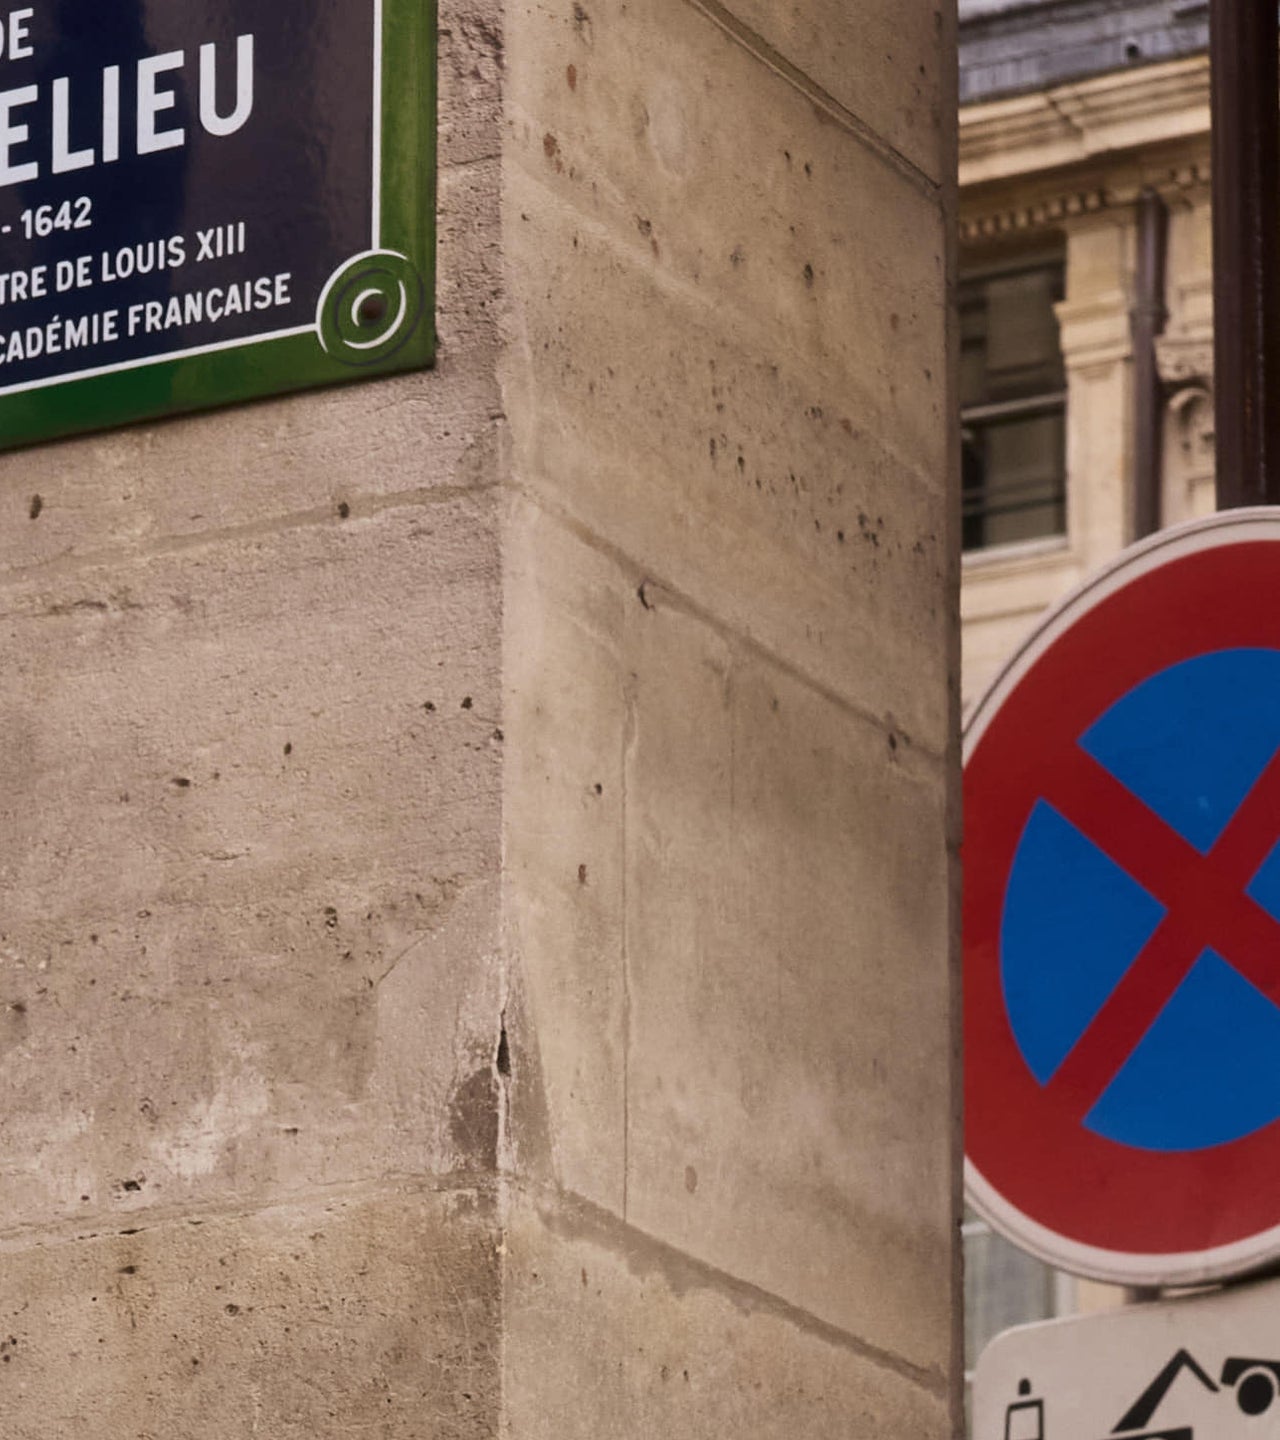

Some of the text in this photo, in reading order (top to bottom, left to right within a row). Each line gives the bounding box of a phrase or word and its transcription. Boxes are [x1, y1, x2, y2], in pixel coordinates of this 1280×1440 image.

[20, 196, 92, 240] 1642
[55, 255, 93, 293] DE
[101, 235, 186, 283] LOUIS
[195, 221, 245, 262] XIII
[127, 272, 292, 337] FRANÇAISE
